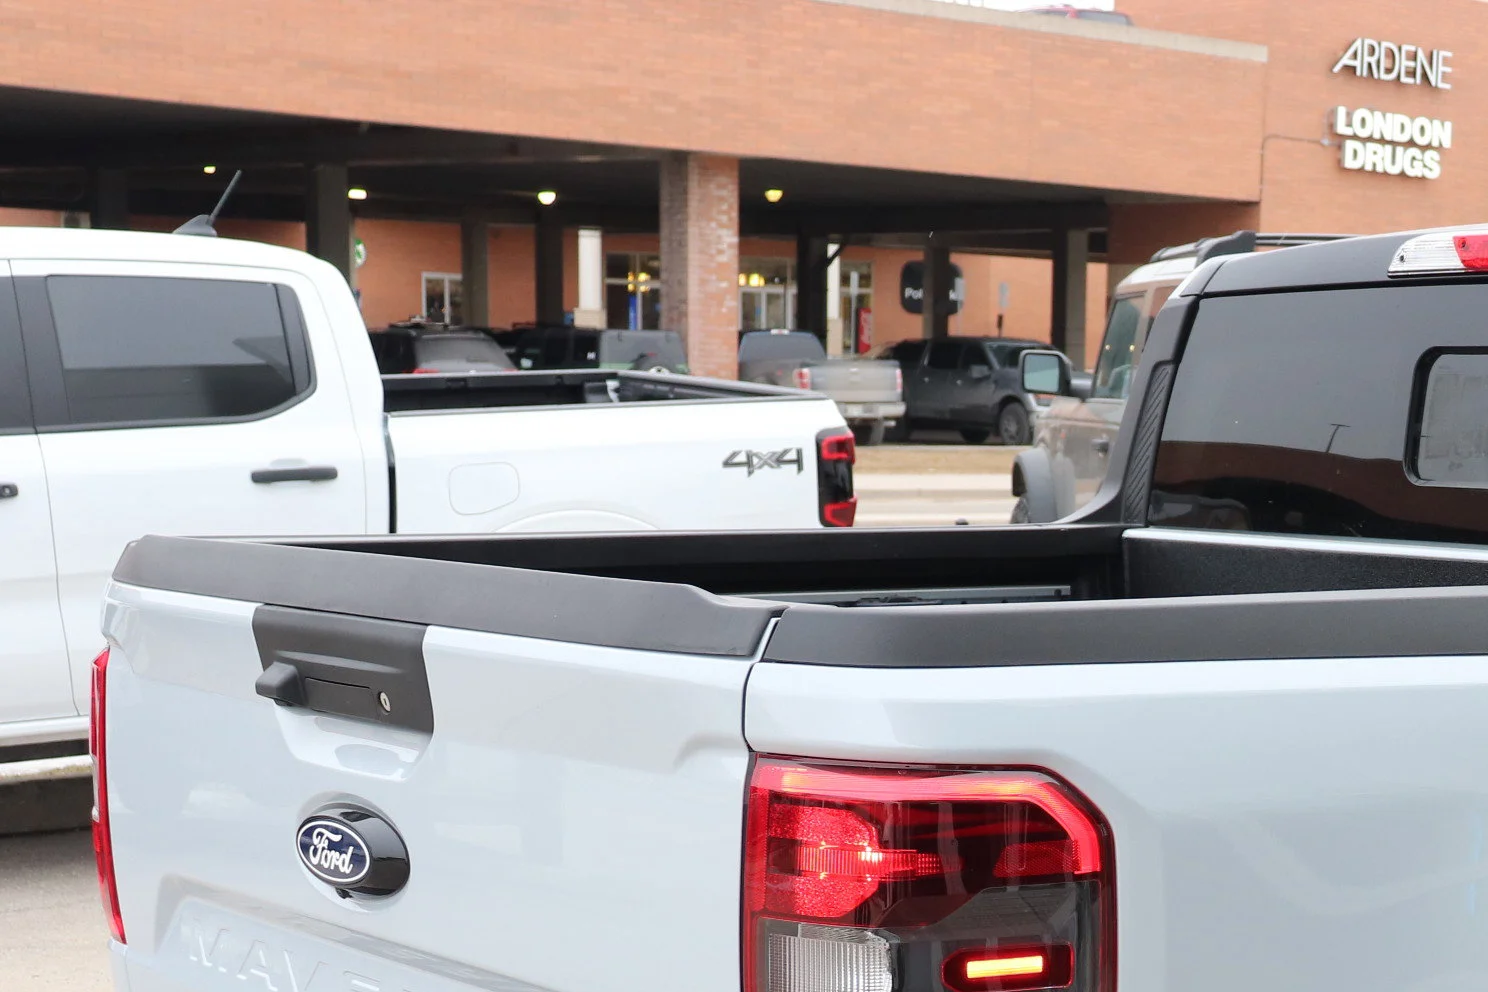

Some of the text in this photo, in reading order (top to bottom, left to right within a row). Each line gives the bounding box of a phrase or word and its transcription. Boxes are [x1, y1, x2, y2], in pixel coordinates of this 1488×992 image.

[1332, 37, 1453, 89] ARDENE
[1335, 105, 1452, 149] LONDON
[1341, 139, 1441, 179] DRUGS
[904, 287, 924, 300] Pol
[308, 826, 356, 875] Ford
